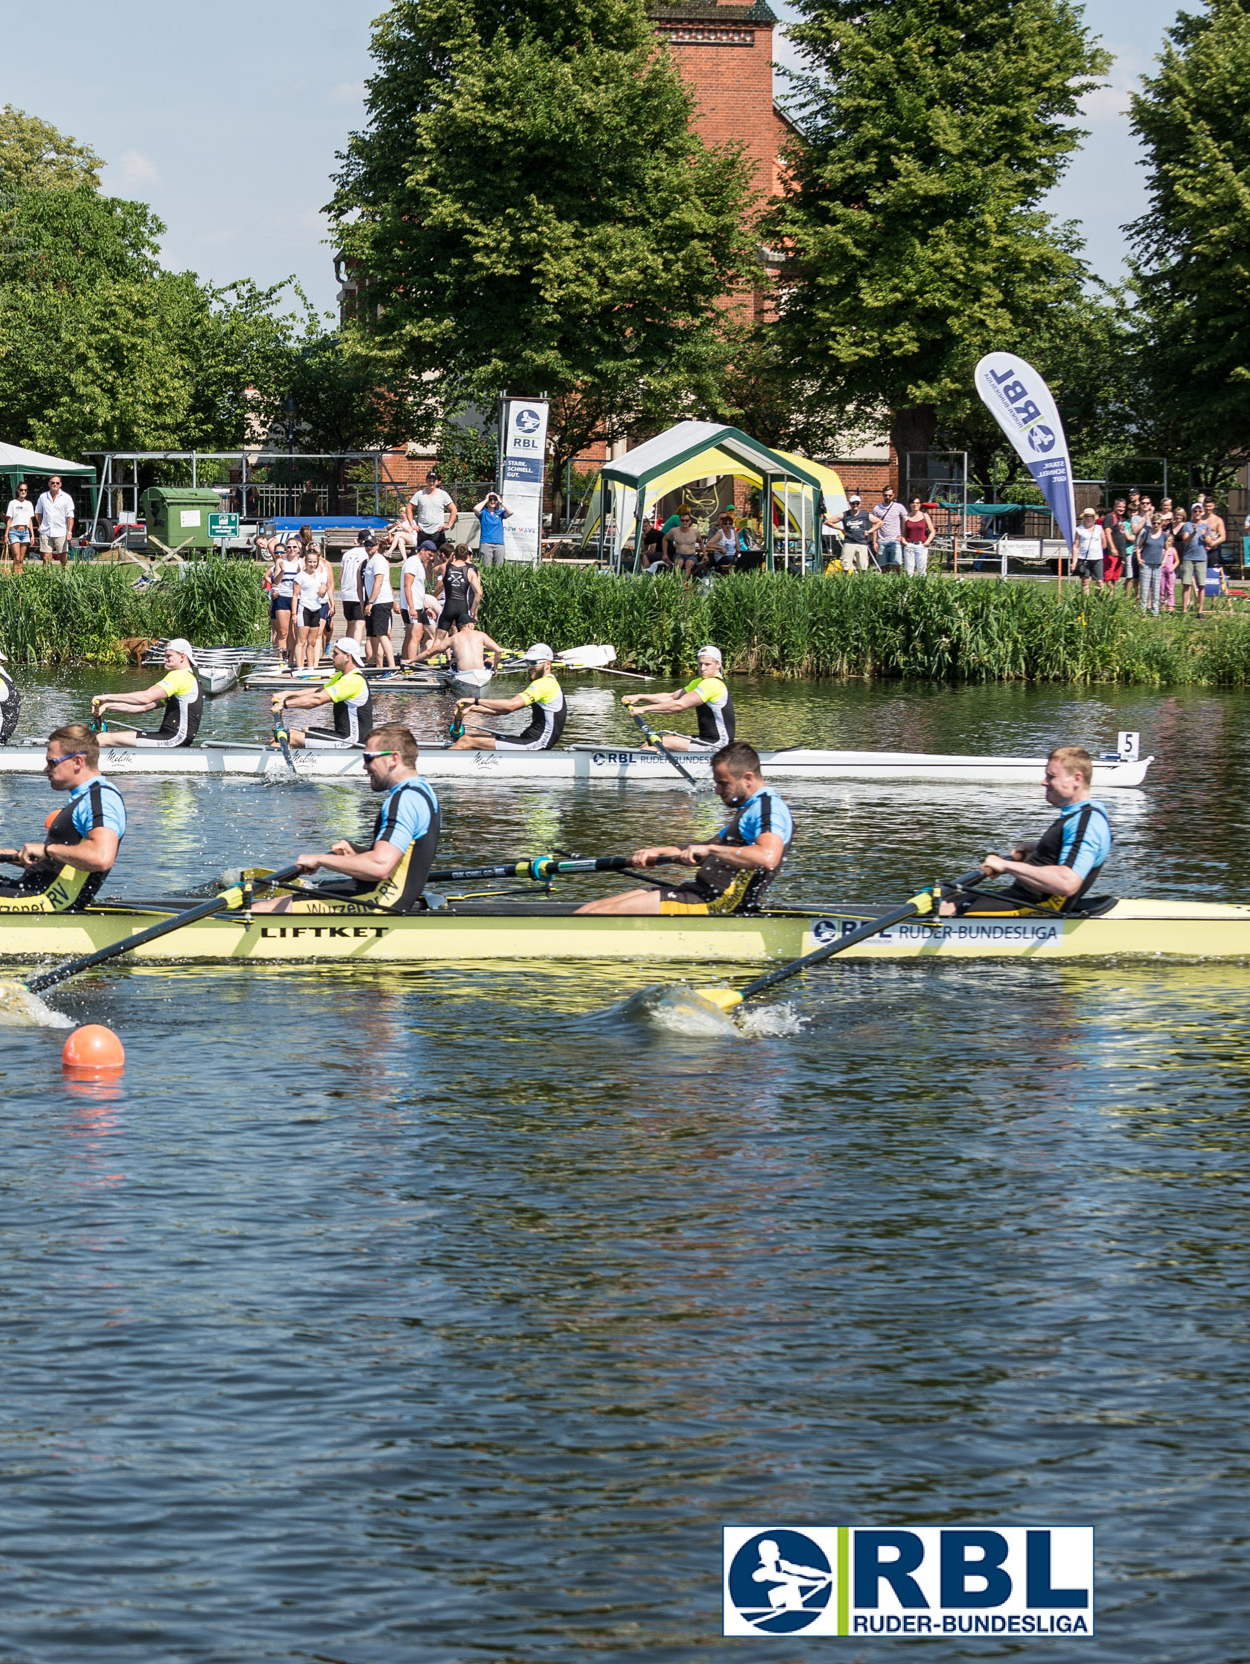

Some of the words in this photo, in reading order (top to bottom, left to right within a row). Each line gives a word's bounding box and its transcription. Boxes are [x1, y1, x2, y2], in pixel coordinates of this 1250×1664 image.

[513, 438, 538, 448] RBL
[1124, 733, 1133, 753] 5
[608, 751, 637, 763] RBL
[47, 882, 69, 909] RV
[379, 877, 398, 901] RV
[261, 927, 389, 938] LIFTKET
[899, 925, 1058, 940] RUDER-BUNDESLIGA
